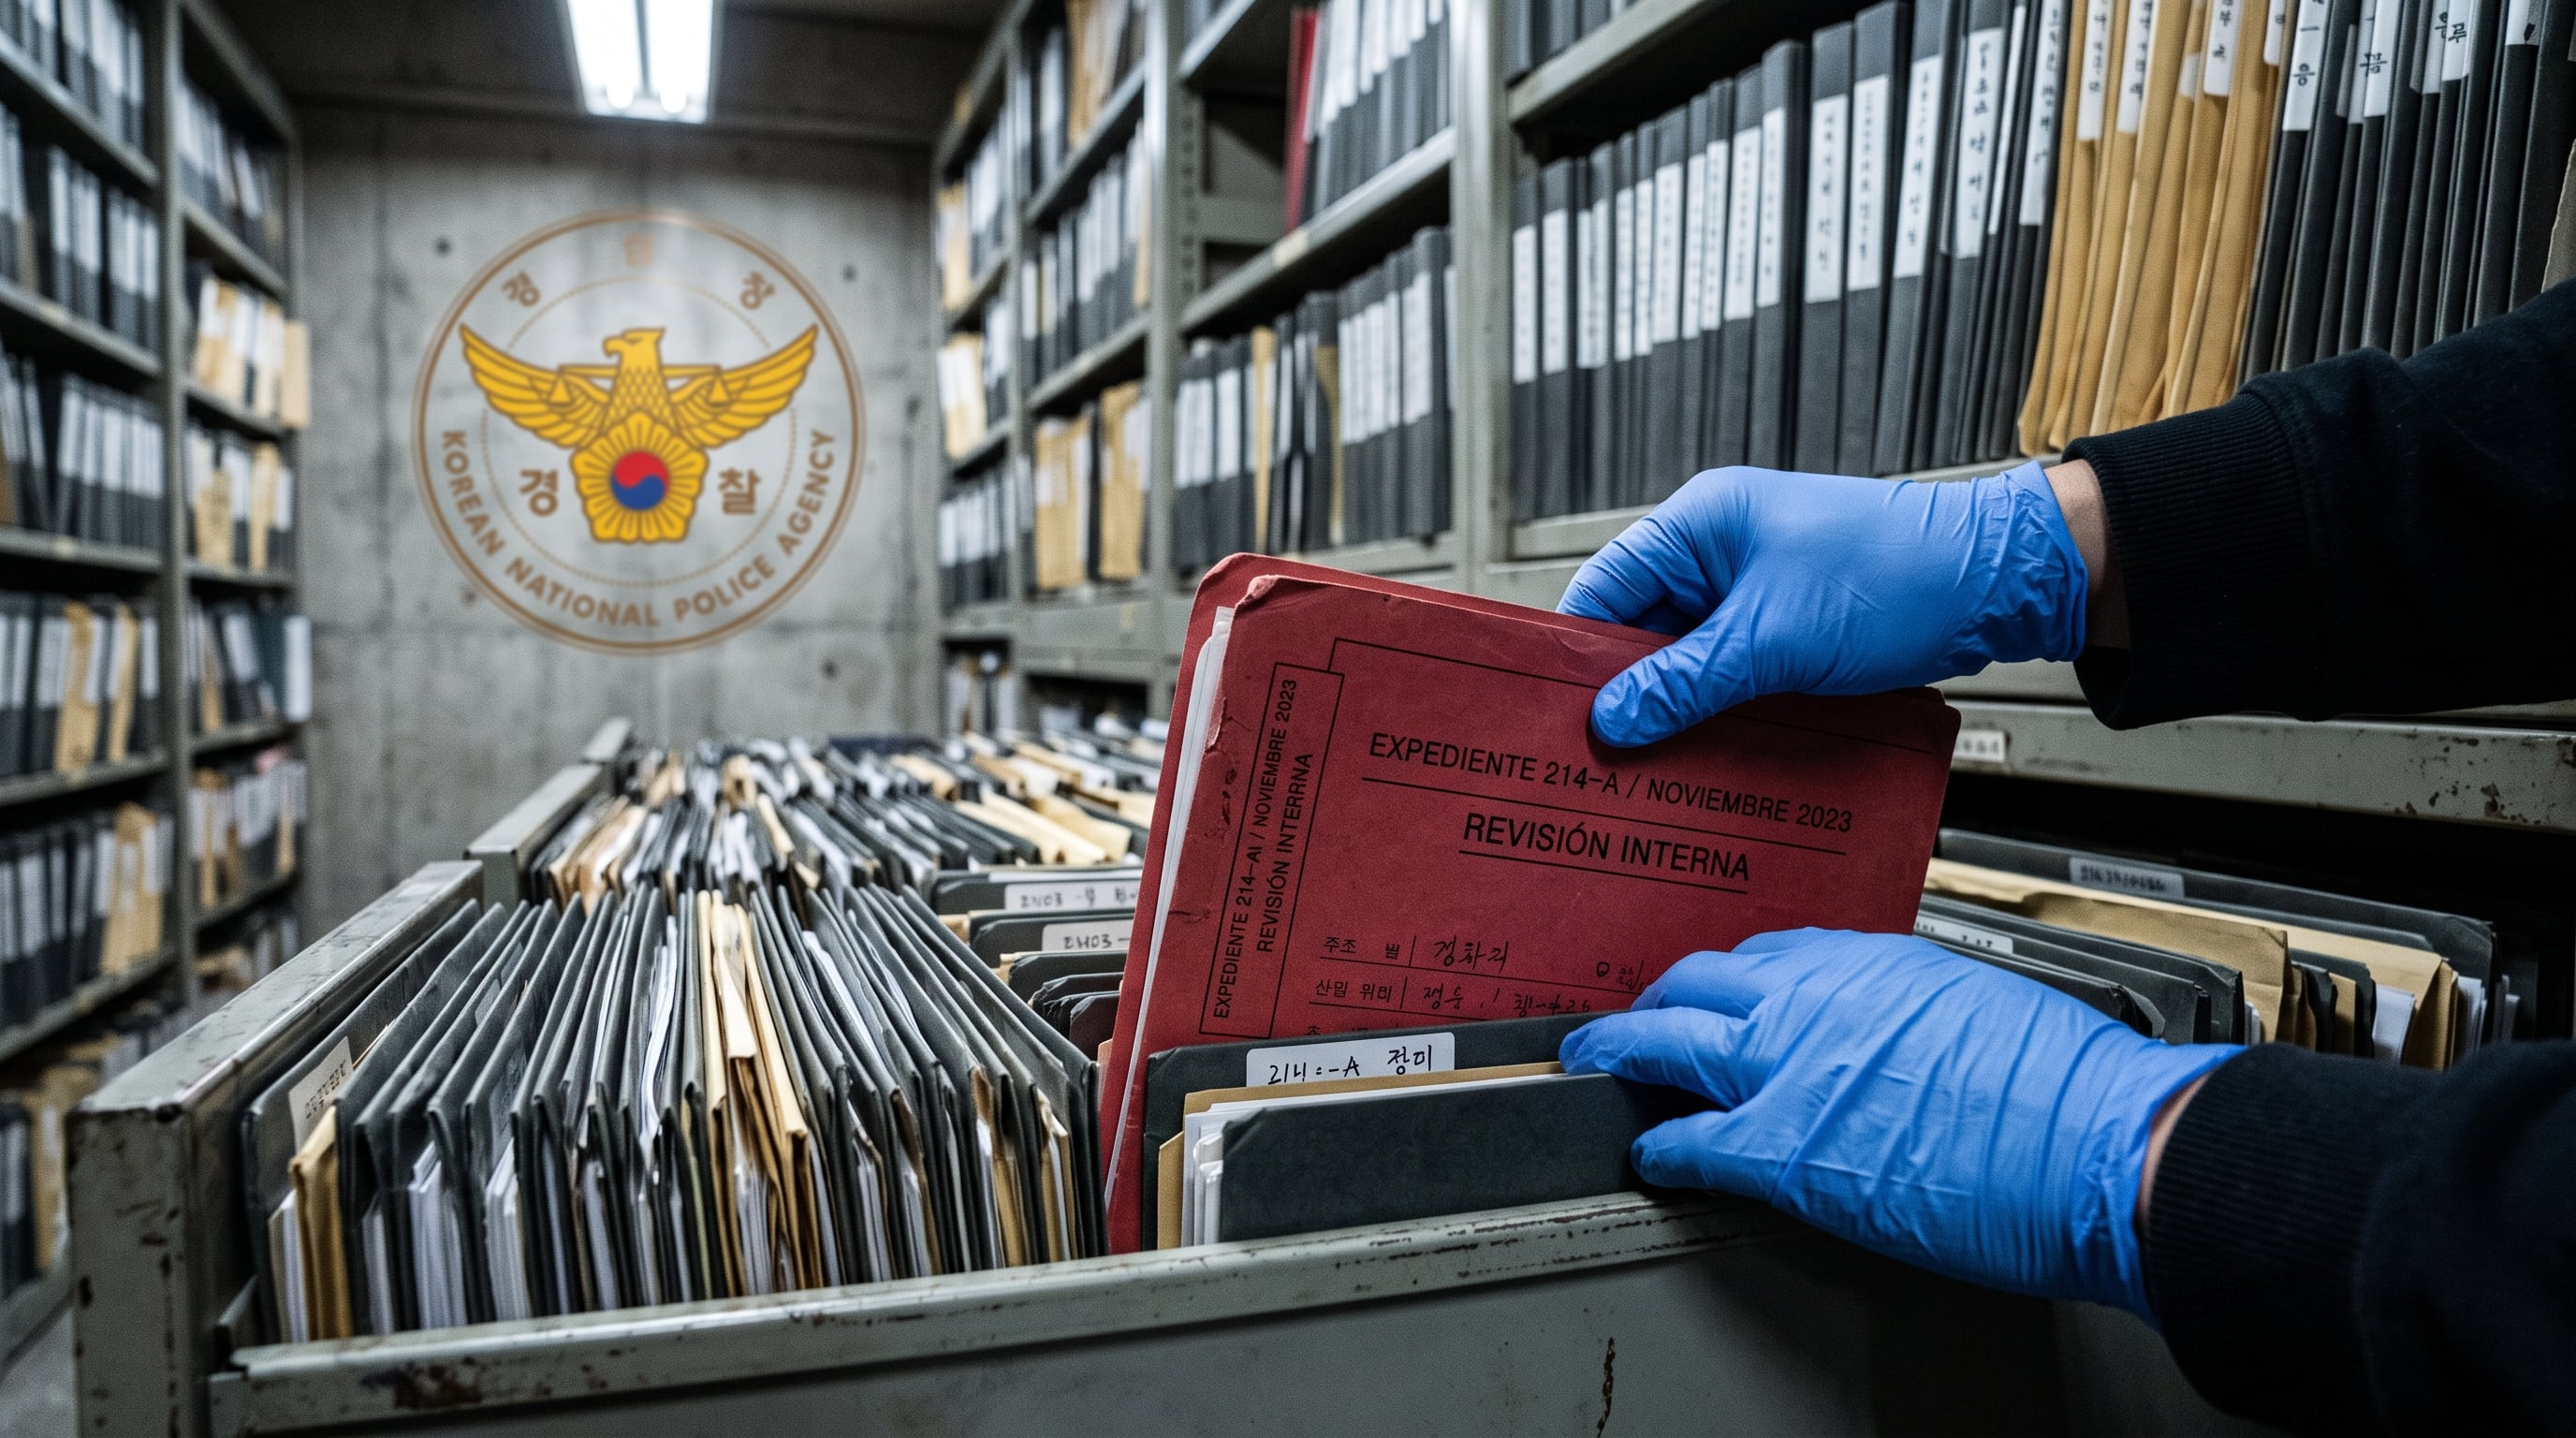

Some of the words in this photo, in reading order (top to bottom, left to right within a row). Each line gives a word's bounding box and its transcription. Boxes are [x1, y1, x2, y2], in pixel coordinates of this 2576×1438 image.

[442, 430, 505, 558] KOREAN
[504, 556, 661, 627] NATIONAL
[673, 554, 778, 623] POLICE
[775, 428, 836, 558] AGENCY
[520, 468, 559, 517] 경
[717, 467, 762, 516] 찰
[1213, 912, 1249, 1020] EXPEDIENTE
[1252, 727, 1288, 828] NOVIEMBRE
[1275, 679, 1297, 724] 2023
[1256, 860, 1292, 953] REVISIÓN
[1276, 754, 1313, 854] INTERRNA
[1369, 731, 1538, 782] EXPEDIENTE
[1647, 778, 1791, 823] NOVIEMBRE
[1795, 802, 1853, 833] 2023
[1463, 812, 1611, 860] REVISIÓN
[1619, 835, 1749, 881] INTERNA
